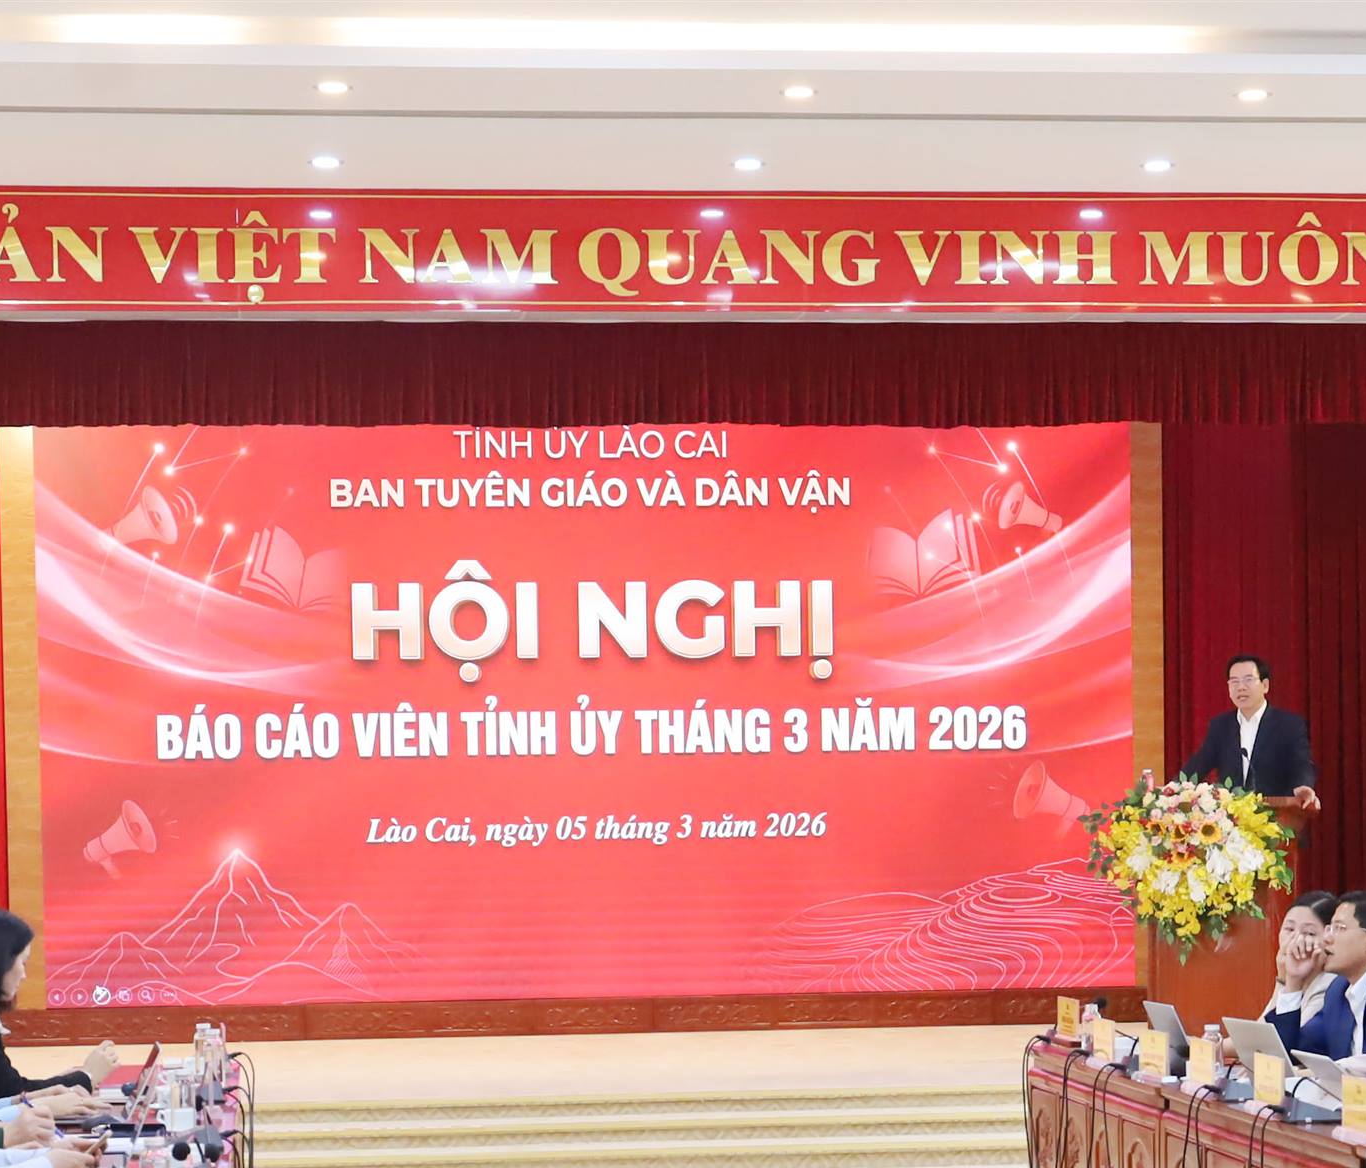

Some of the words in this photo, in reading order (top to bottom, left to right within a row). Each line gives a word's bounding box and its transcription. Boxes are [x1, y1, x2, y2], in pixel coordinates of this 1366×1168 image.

[129, 210, 335, 305] VIỆT
[361, 227, 559, 286] NAM
[578, 225, 879, 298] QUANG
[894, 227, 1114, 286] VINH
[599, 427, 665, 458] LÀO
[675, 431, 726, 458] CAI
[331, 479, 404, 507] BAN
[414, 471, 530, 507] TUYÊN
[541, 471, 627, 507] GIÁO
[636, 470, 685, 506] VÀ
[696, 470, 768, 506] DÂN
[778, 470, 849, 513] VẬN
[352, 560, 538, 682] HỘI
[578, 580, 833, 678] NGHỊ
[157, 704, 241, 759] BÁO
[256, 703, 339, 758] CÁO
[352, 702, 448, 757] VIÊN
[460, 695, 556, 756] TỈNH
[570, 695, 623, 755] ỦY
[635, 699, 771, 753] THÁNG
[784, 708, 808, 752] 3
[821, 697, 915, 751] NĂM
[929, 706, 1026, 750] 2026
[366, 818, 417, 842] Lào
[425, 817, 476, 846] Cai,
[486, 816, 548, 847] ngày
[556, 816, 587, 840] 05
[595, 815, 670, 844] tháng
[676, 814, 692, 838] 3
[700, 814, 756, 838] năm
[764, 812, 827, 836] 2026
